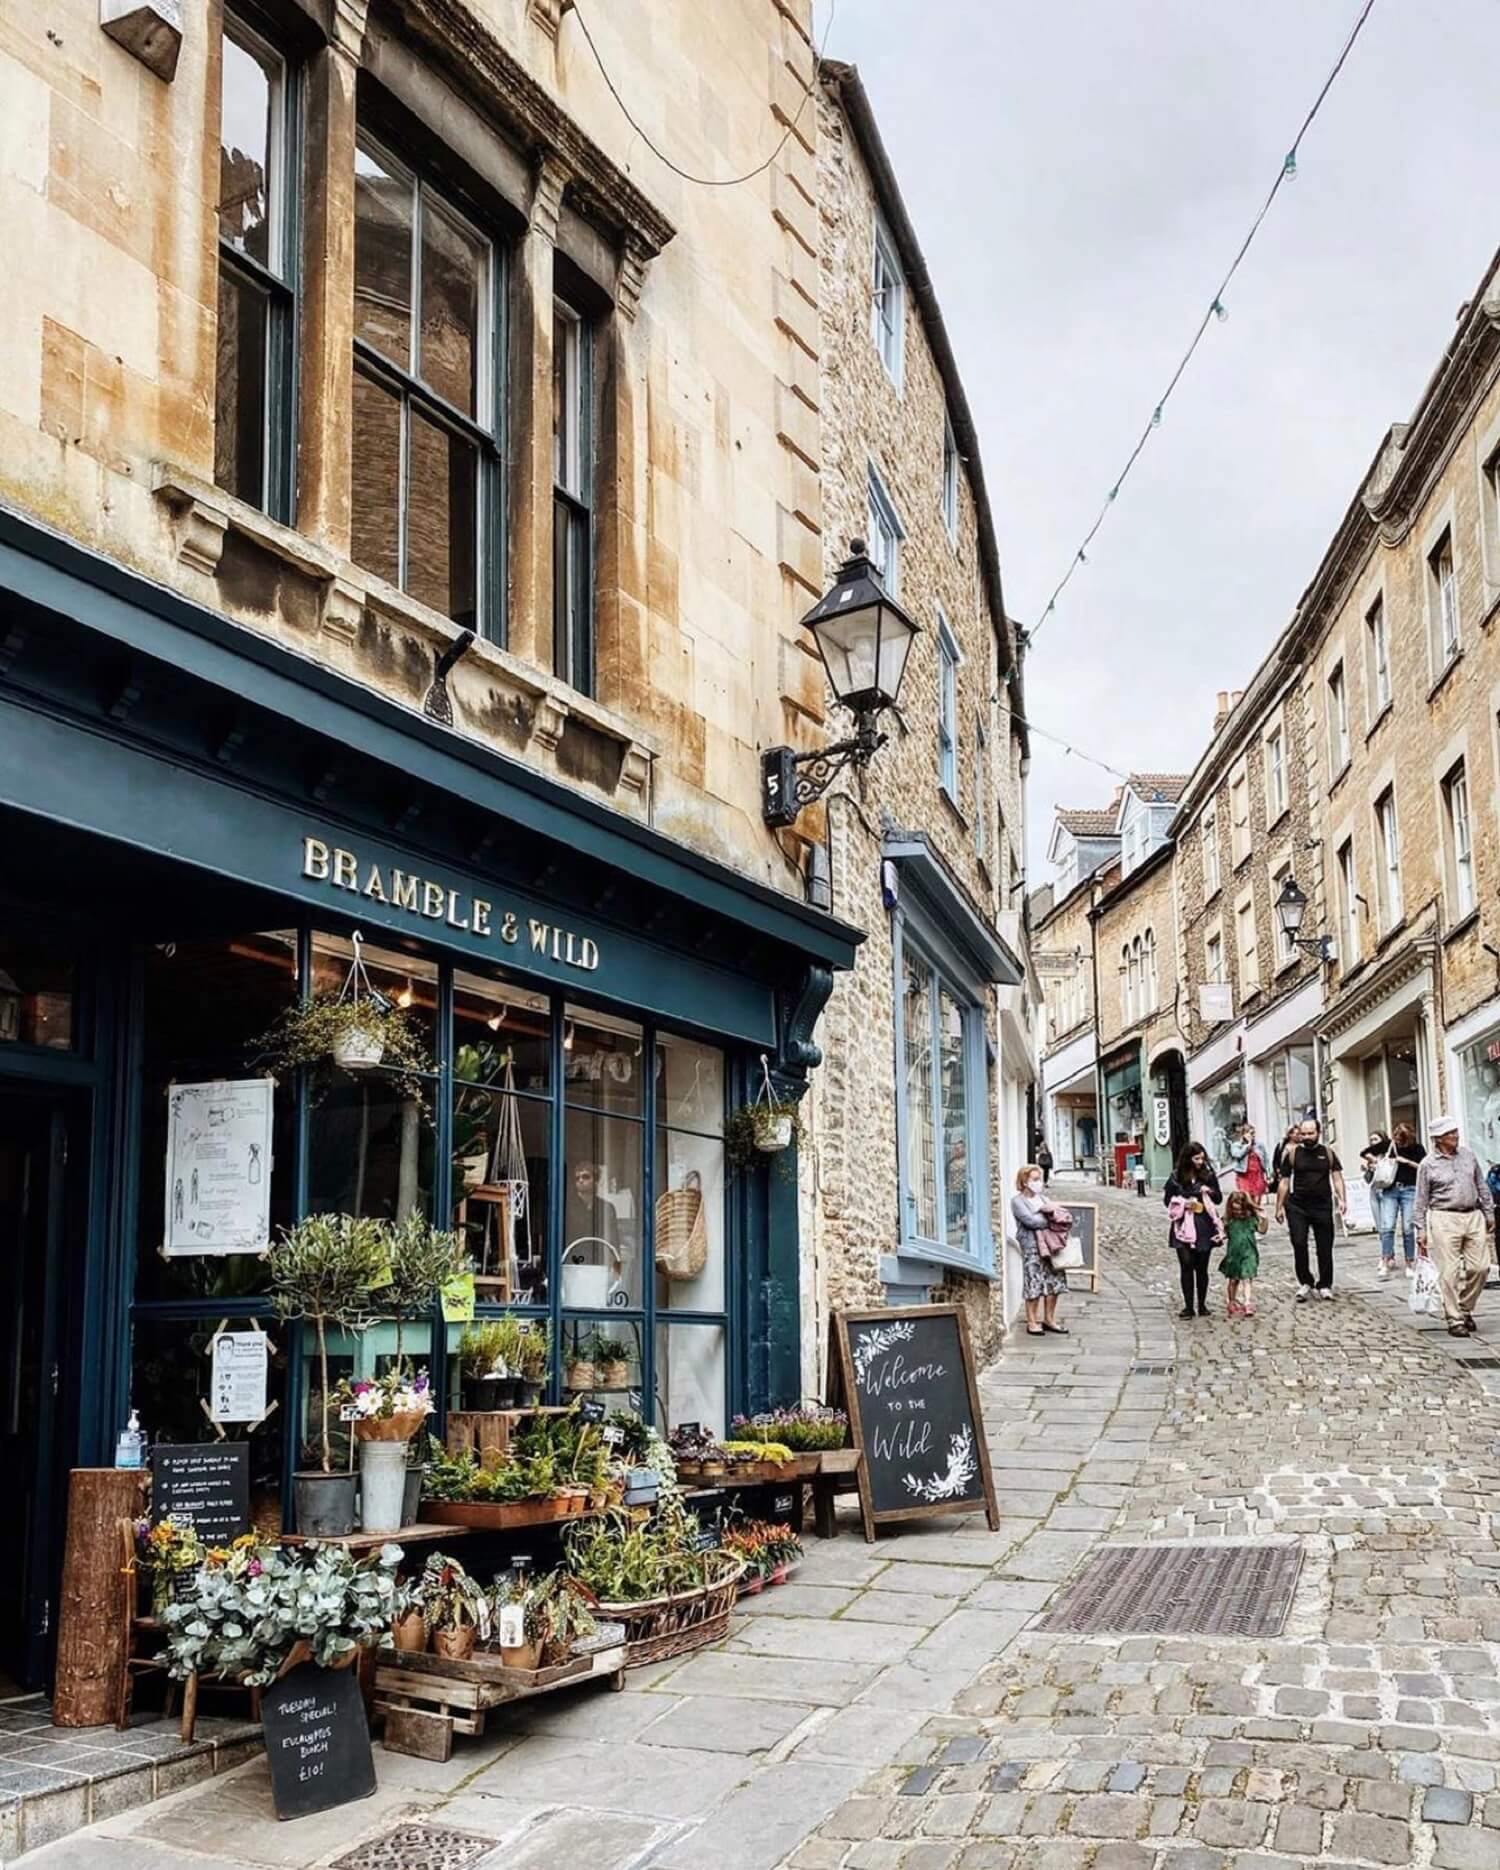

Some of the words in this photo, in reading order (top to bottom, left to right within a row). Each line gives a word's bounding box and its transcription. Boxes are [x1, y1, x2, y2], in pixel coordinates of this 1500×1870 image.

[767, 773, 779, 796] 5
[303, 836, 492, 936] BRAMBLE
[501, 911, 519, 944] &
[528, 918, 600, 971] WILD
[1156, 1101, 1168, 1139] OPEN
[865, 1354, 948, 1396] Welcome
[887, 1401, 902, 1412] TO
[908, 1399, 926, 1410] THE
[873, 1420, 935, 1461] Wild
[278, 1697, 316, 1716] TUESDAY
[299, 1761, 324, 1782] £10!
